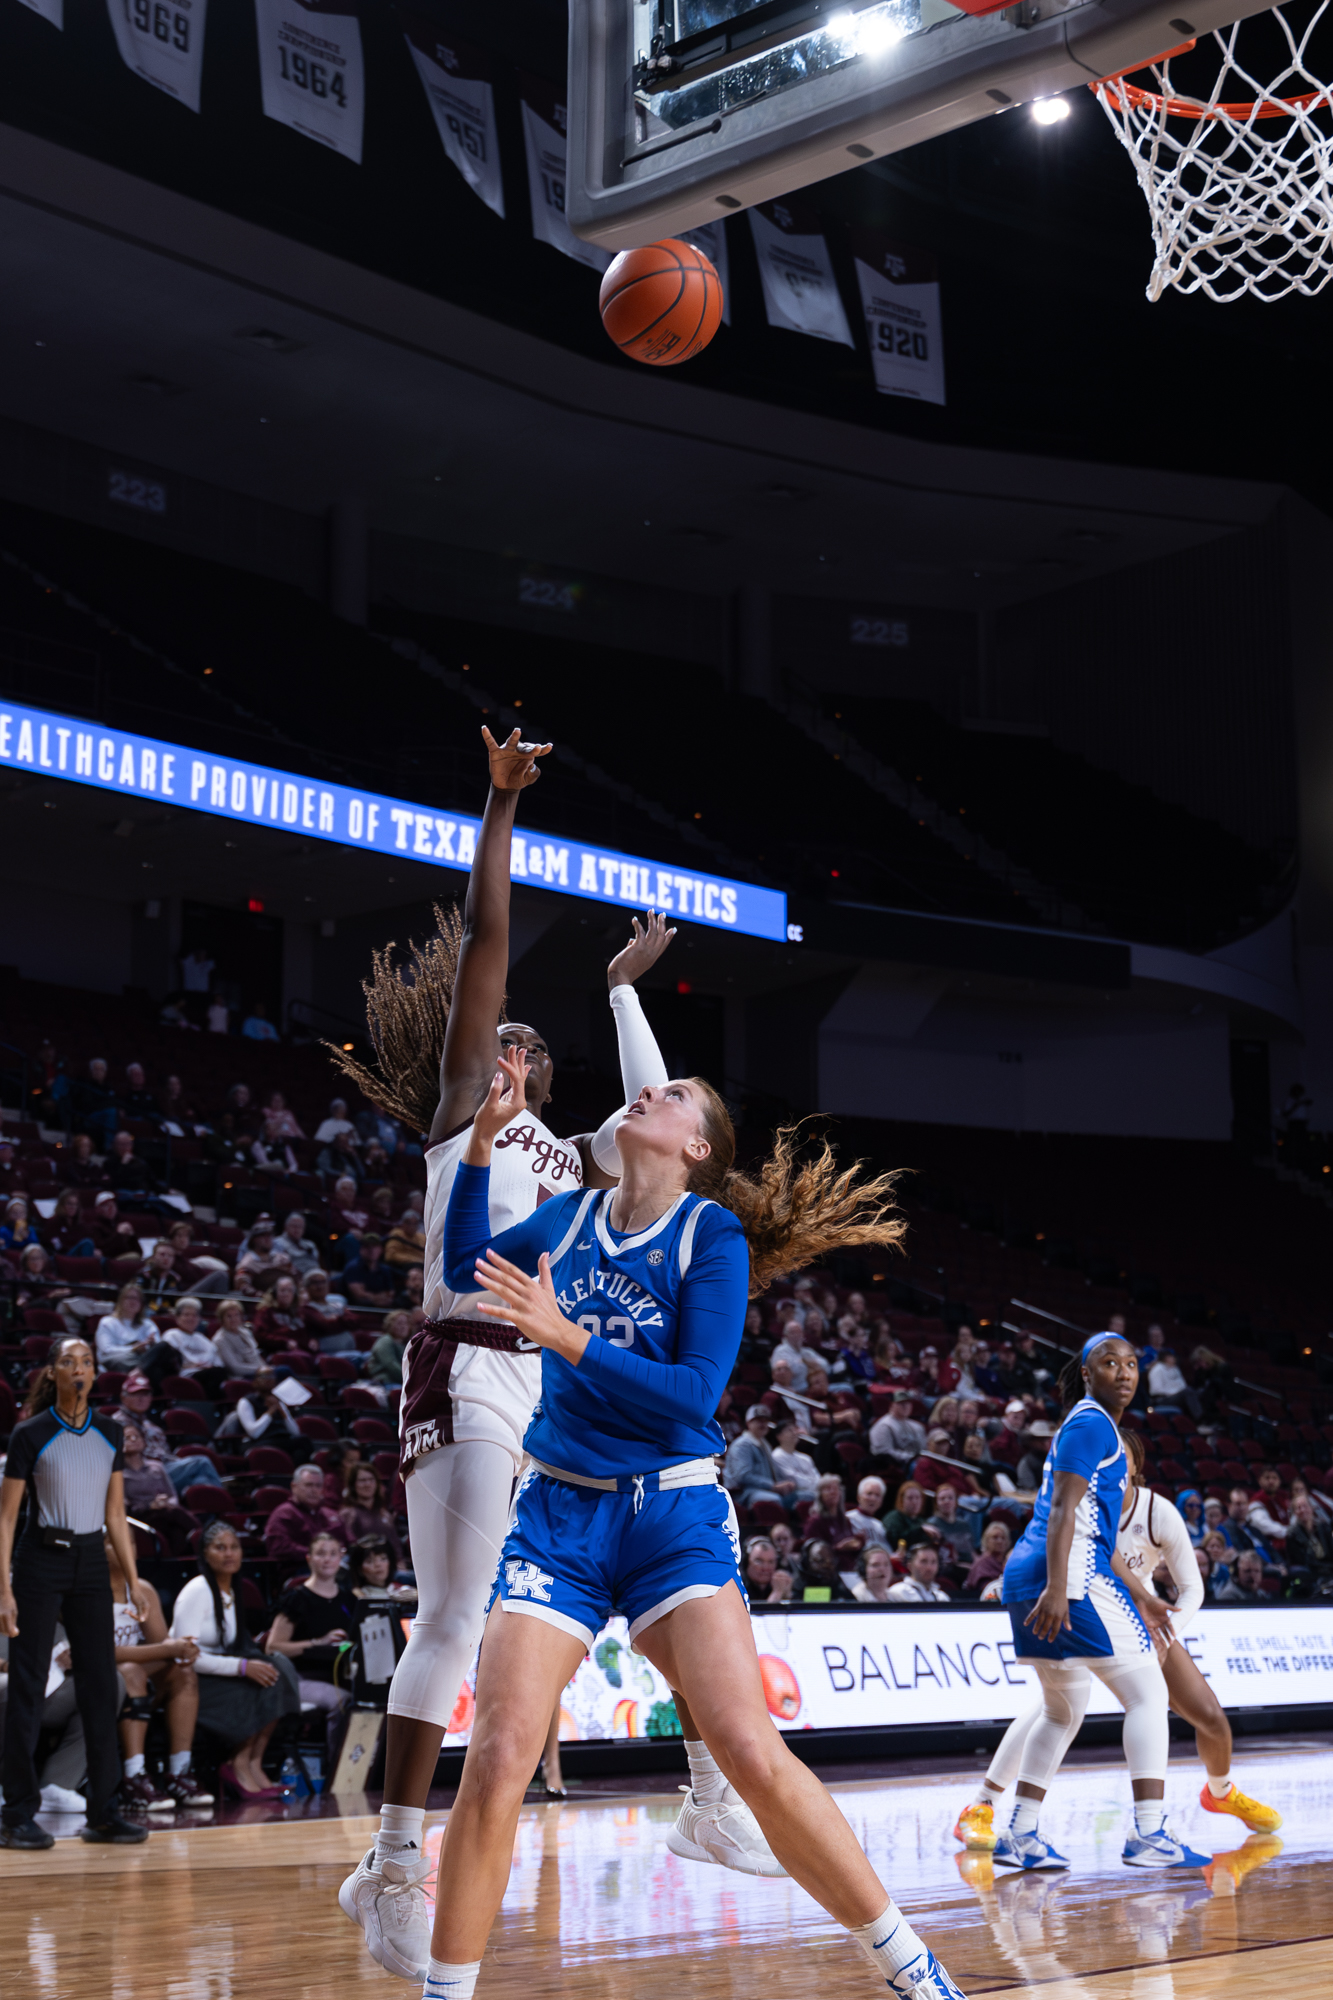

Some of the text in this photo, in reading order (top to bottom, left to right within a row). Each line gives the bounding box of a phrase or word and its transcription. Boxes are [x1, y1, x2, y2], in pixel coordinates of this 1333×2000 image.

[277, 45, 347, 108] 1964
[108, 473, 167, 512] 223
[850, 619, 909, 646] 225
[191, 760, 334, 833] PROVIDER
[348, 798, 380, 843] OF
[391, 807, 477, 867] TEXA
[509, 836, 569, 887] A&M
[579, 853, 737, 924] ATHLETICS
[494, 1125, 583, 1186] Aggie
[648, 1250, 664, 1265] SEC
[557, 1266, 664, 1328] KENTUCKY
[505, 1560, 554, 1602] UK
[1226, 1657, 1261, 1674] FEEL
[1263, 1655, 1290, 1672] THE
